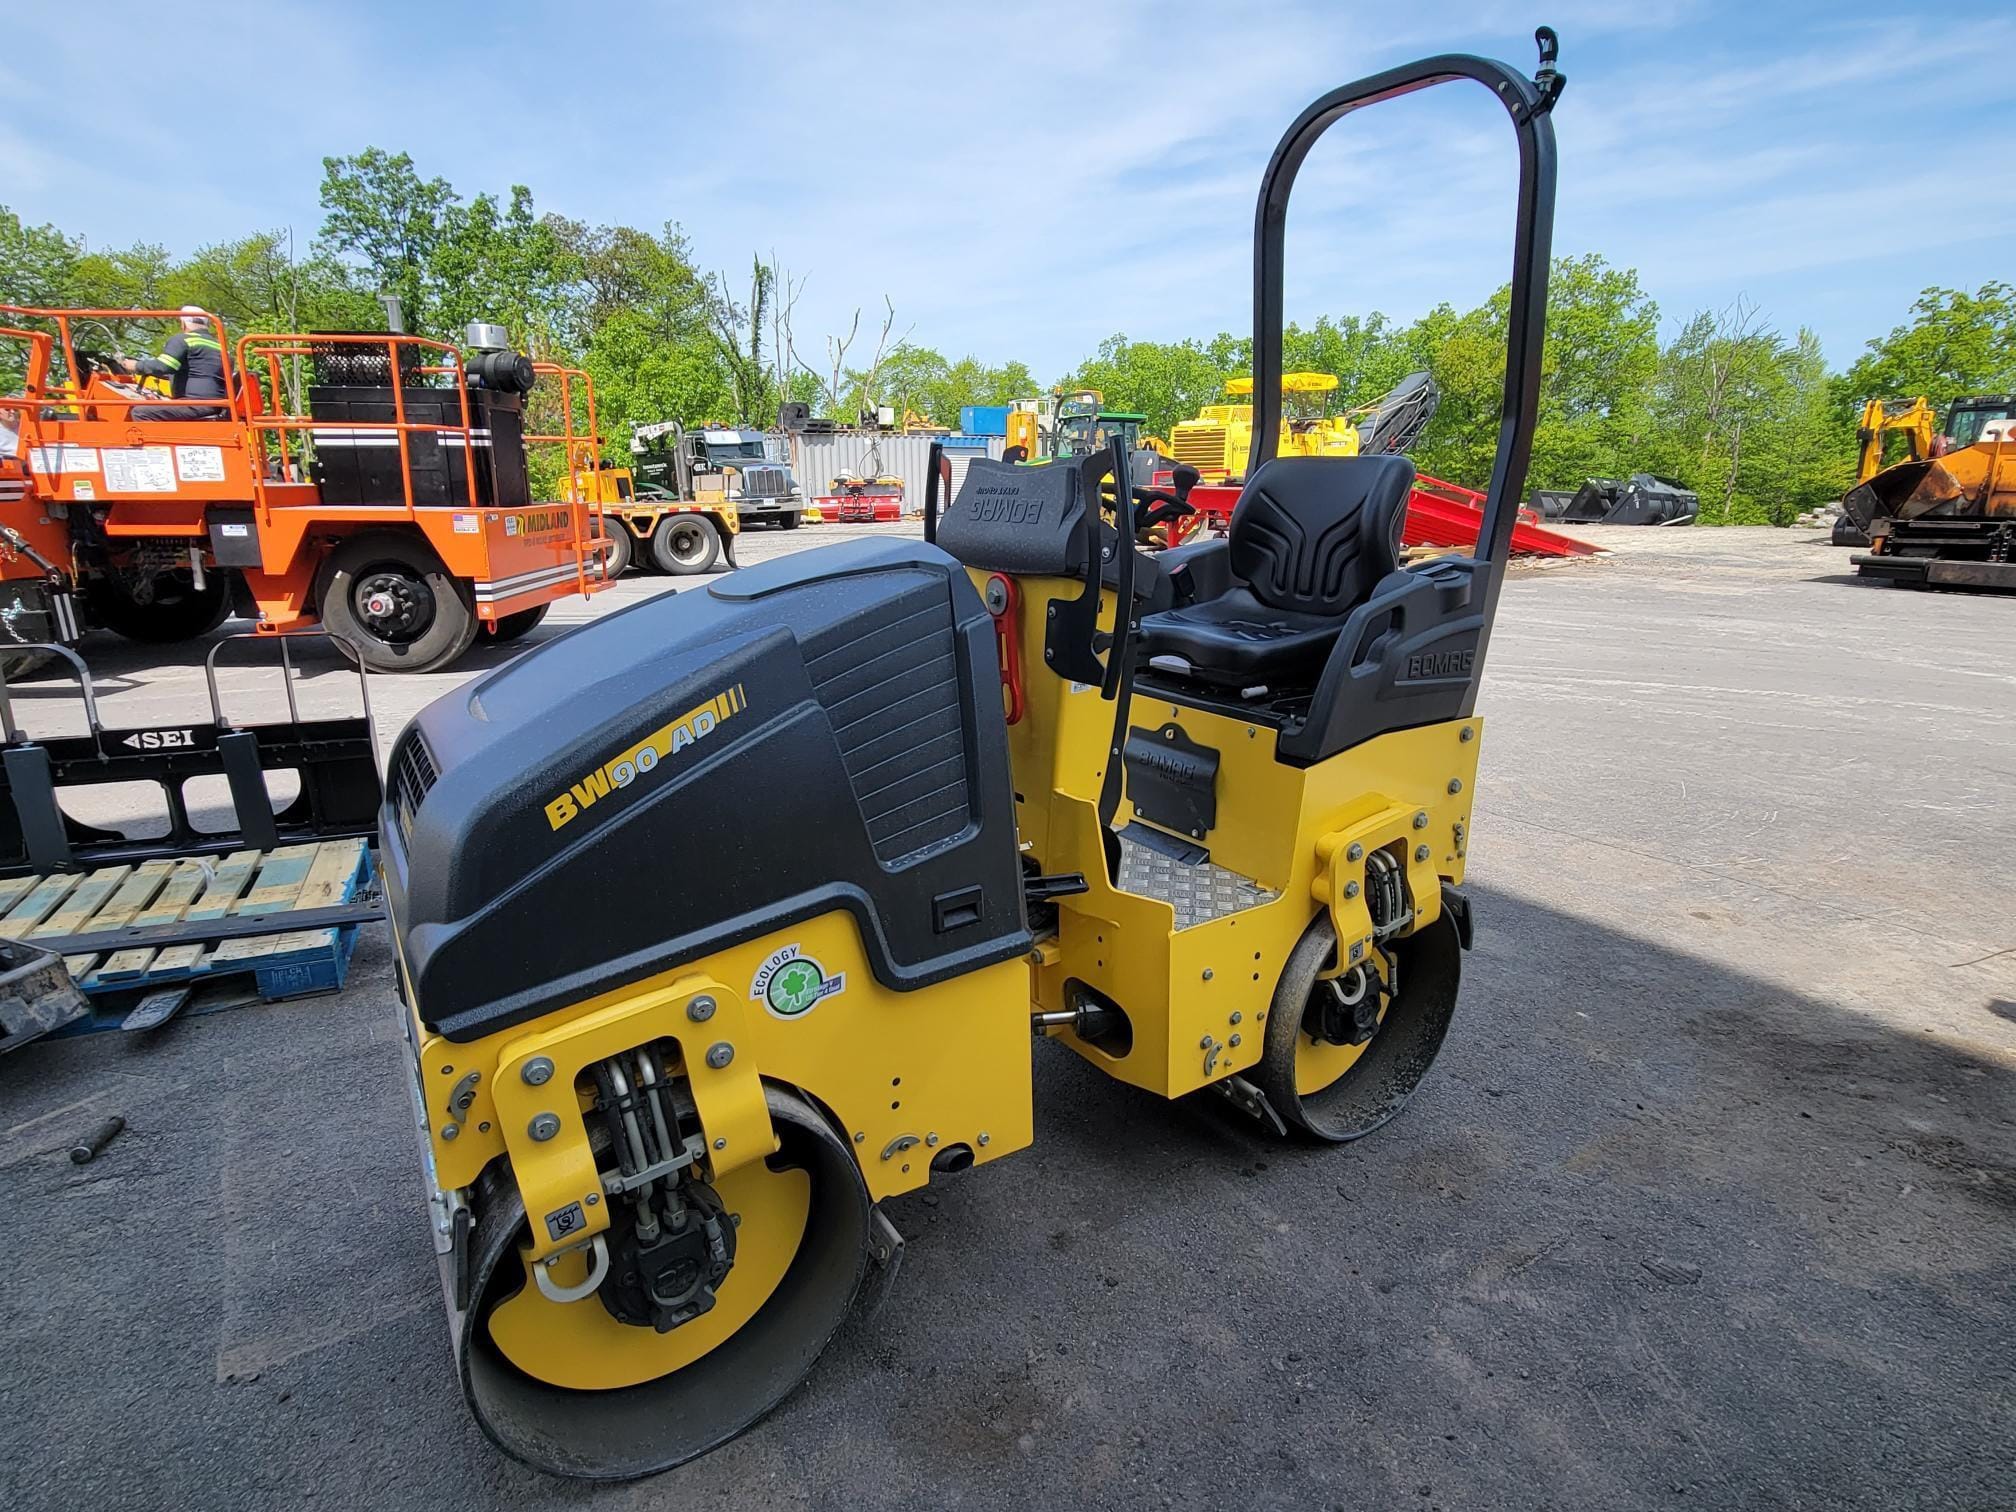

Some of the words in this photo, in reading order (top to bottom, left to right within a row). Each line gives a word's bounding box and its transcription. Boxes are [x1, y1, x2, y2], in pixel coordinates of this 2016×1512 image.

[527, 511, 569, 533] MIDLAND
[969, 498, 1044, 525] BOMAG
[1408, 649, 1474, 678] BOMAG
[141, 729, 195, 749] SEI
[544, 746, 660, 832] BW90
[671, 710, 716, 755] AD
[1140, 751, 1197, 780] BOMAG
[753, 946, 798, 996] ECOLOGY
